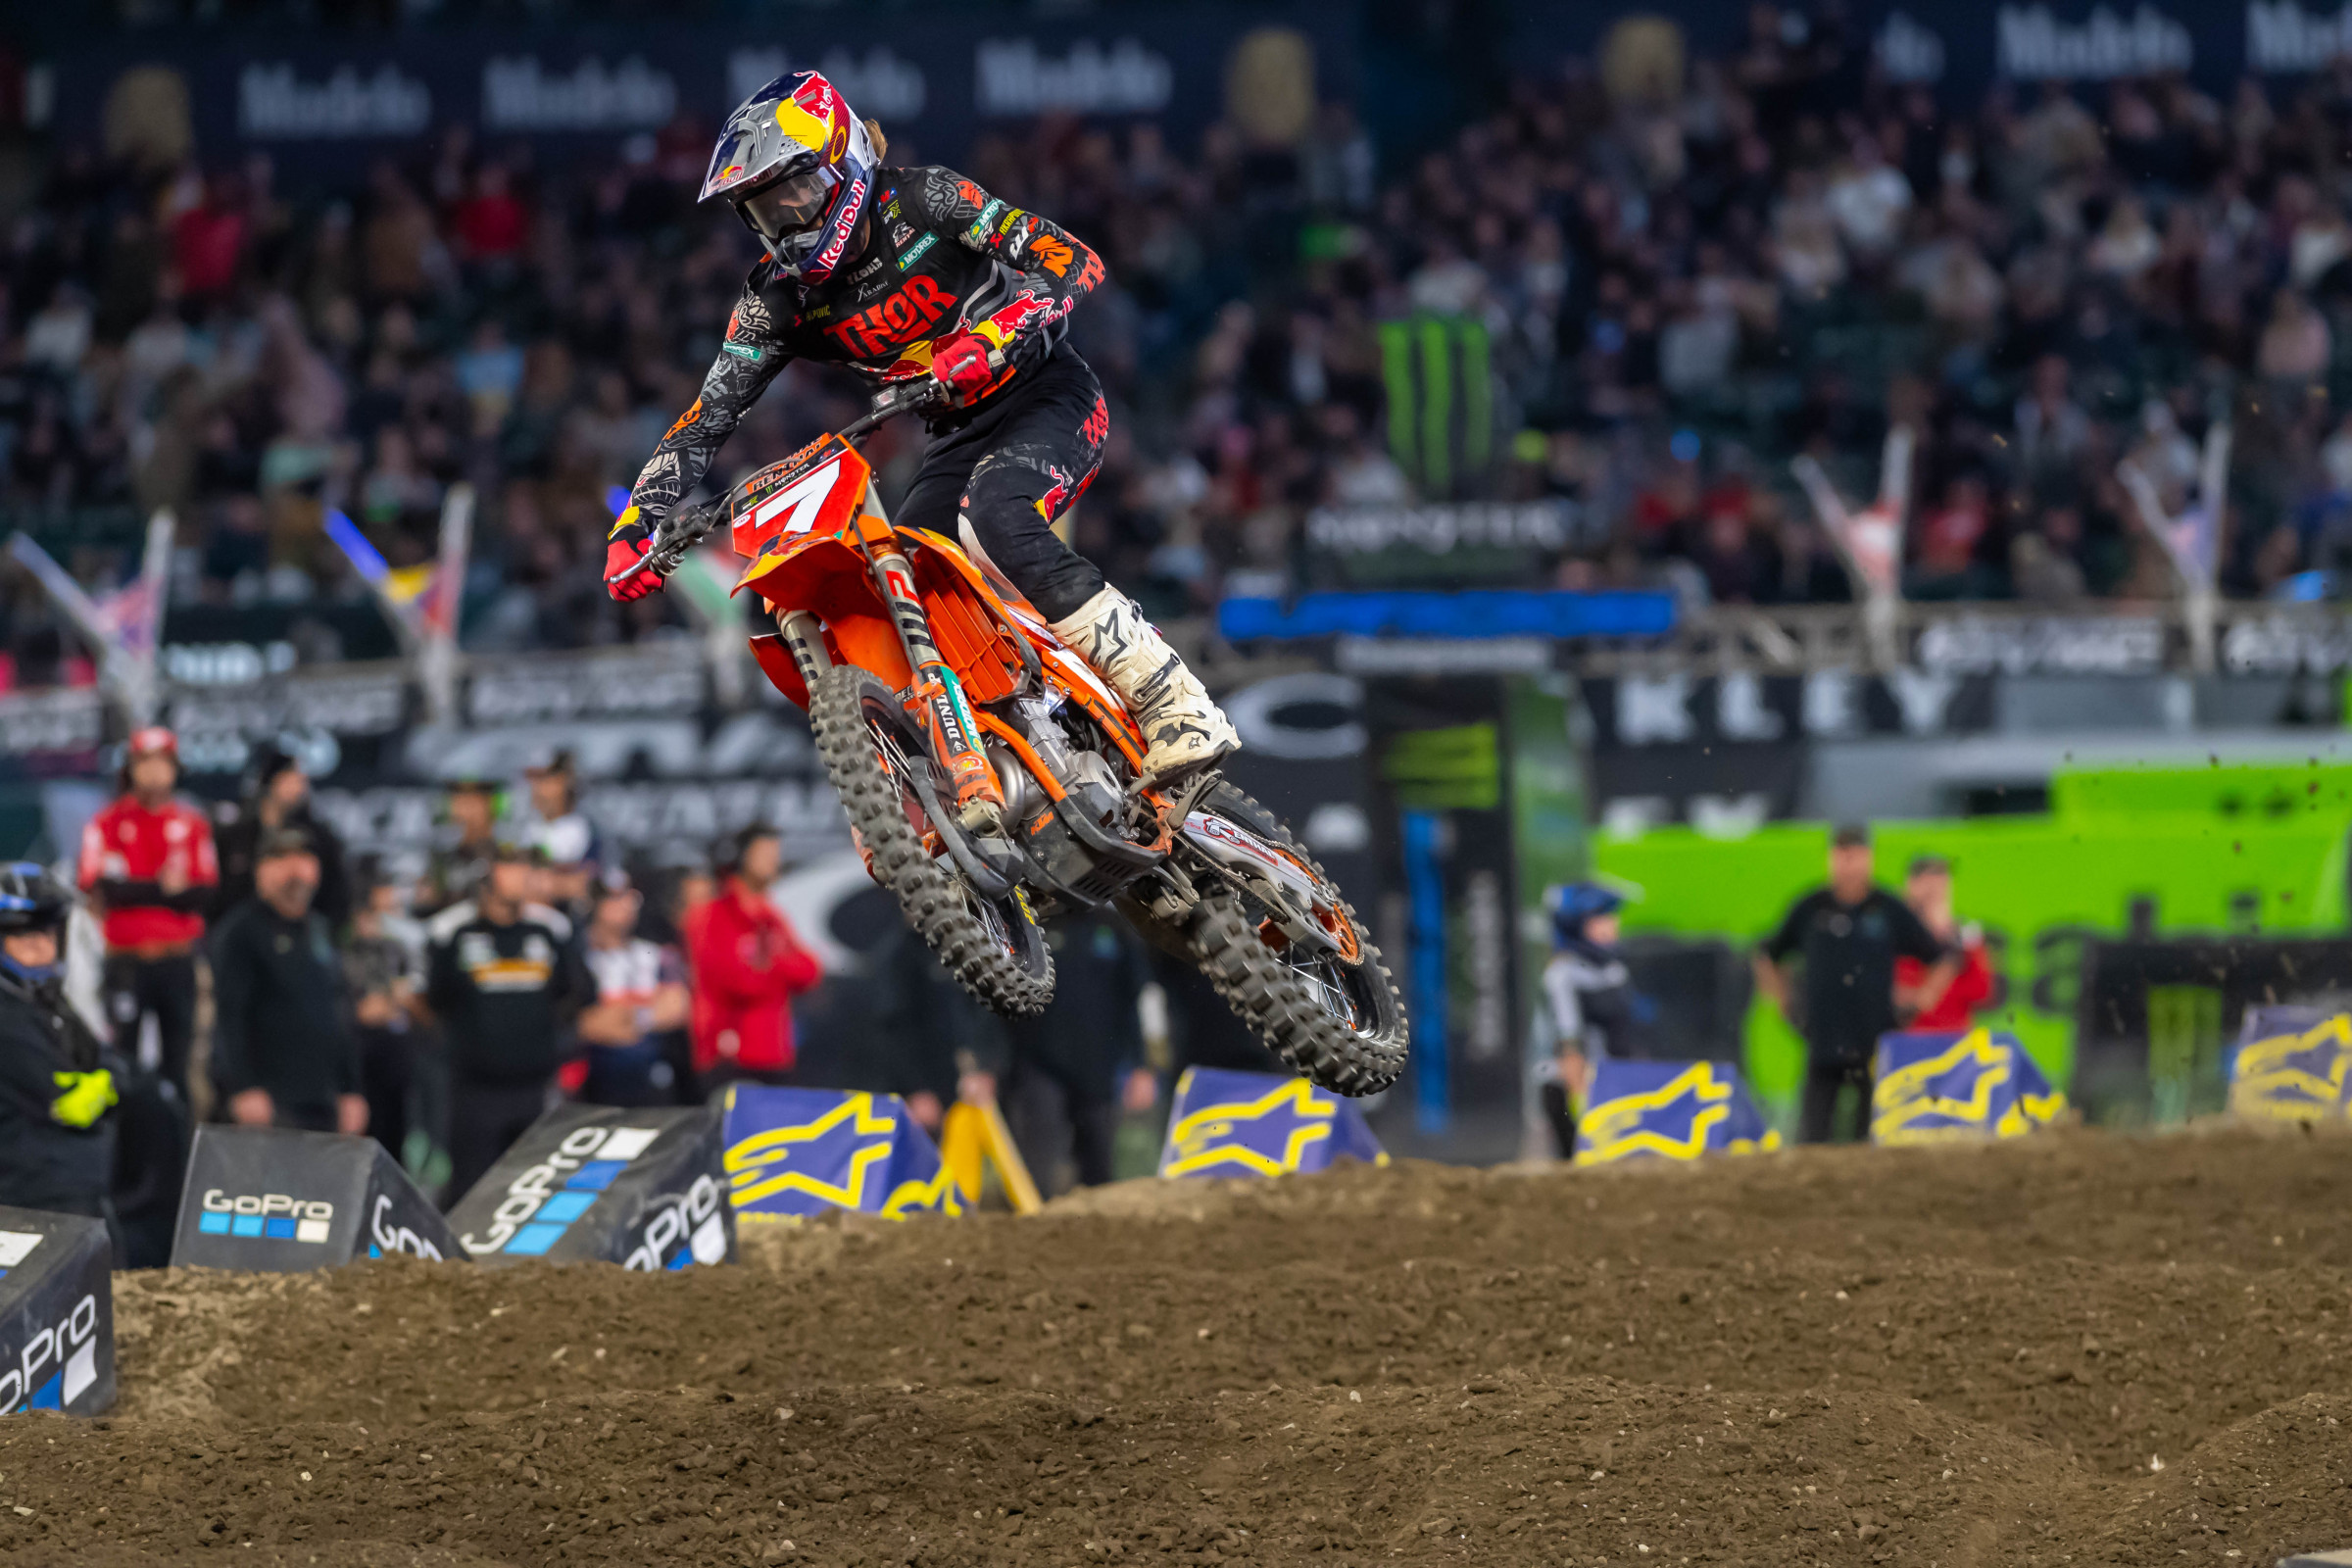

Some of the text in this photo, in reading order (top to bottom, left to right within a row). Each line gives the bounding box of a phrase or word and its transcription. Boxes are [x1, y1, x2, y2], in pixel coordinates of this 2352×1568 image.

[817, 178, 866, 270] Red Bull
[823, 275, 957, 359] THOR
[755, 459, 841, 533] 7
[774, 462, 811, 488] MONSTER
[927, 672, 961, 740] DUNLP
[1031, 810, 1054, 836] KTM
[203, 1189, 334, 1220] GoPro
[460, 1127, 608, 1253] GoPro
[623, 1174, 718, 1272] oPro
[0, 1295, 96, 1416] oPro
